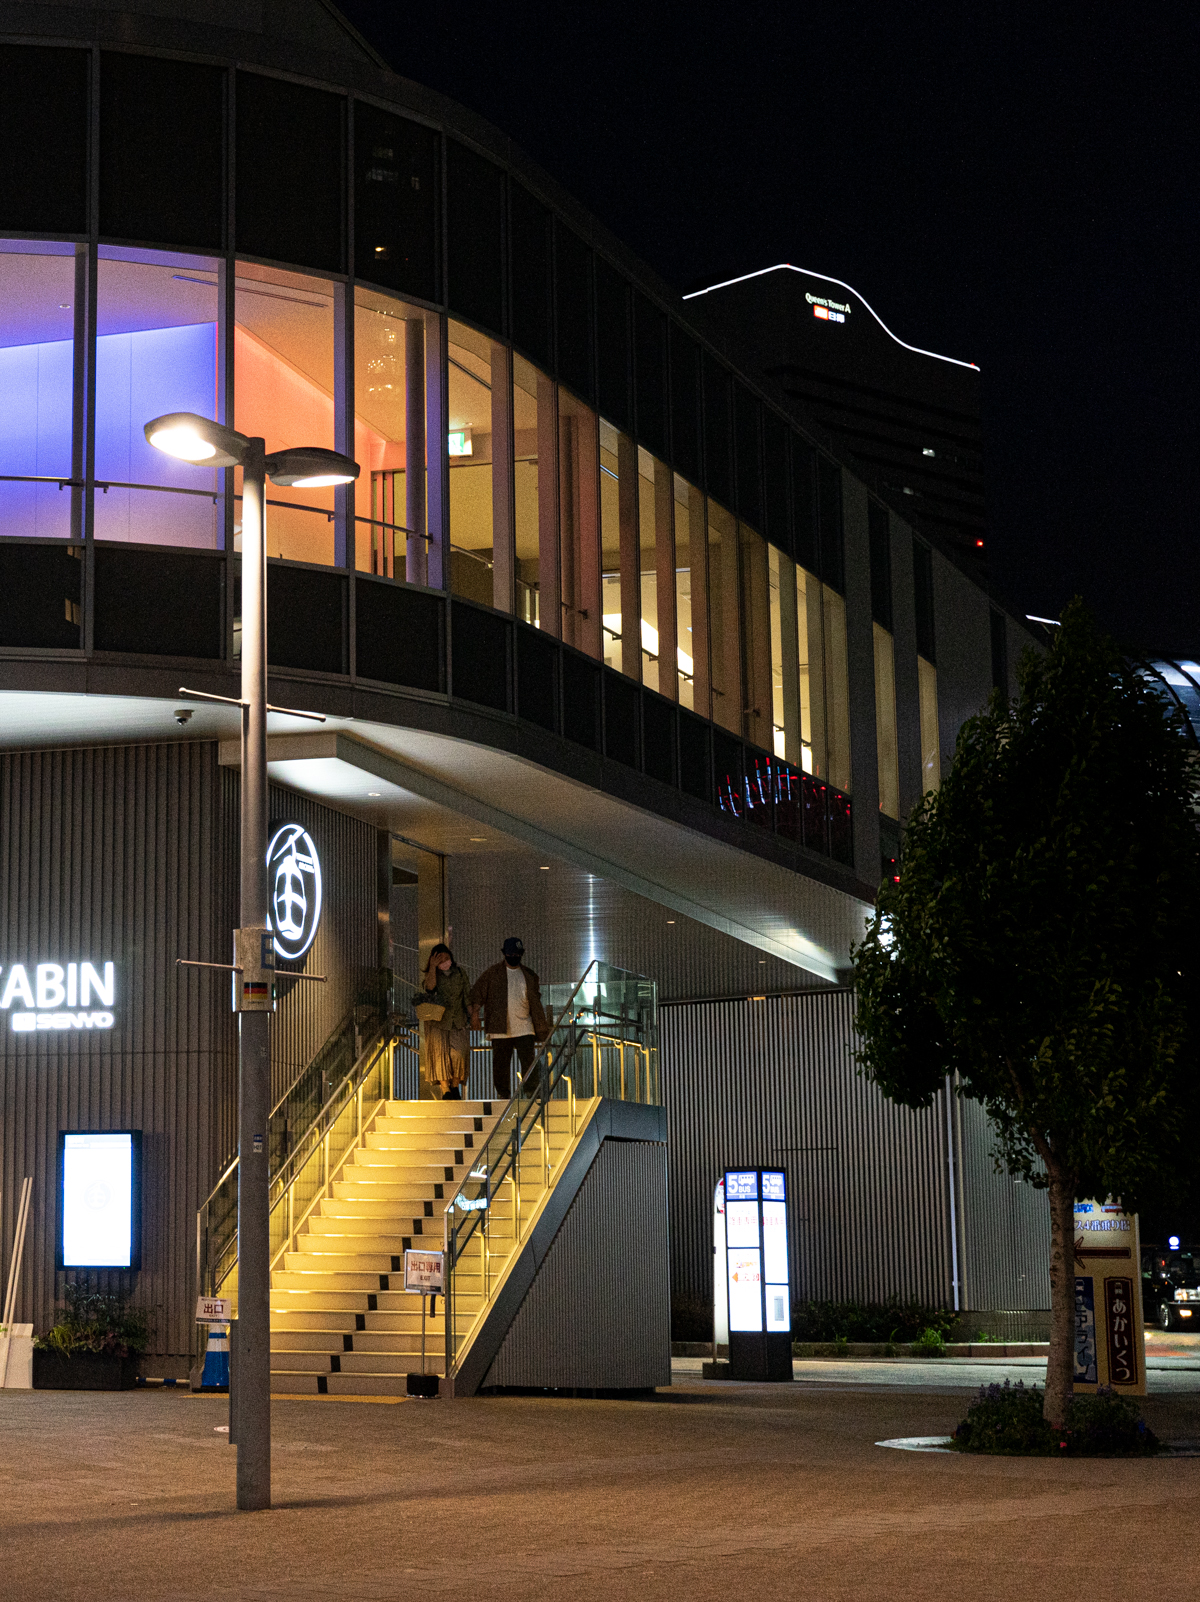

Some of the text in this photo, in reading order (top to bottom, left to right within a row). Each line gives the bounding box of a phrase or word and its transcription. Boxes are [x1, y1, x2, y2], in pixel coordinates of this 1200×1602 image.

[845, 303, 851, 314] A
[37, 1012, 114, 1030] SENYO
[90, 1059, 101, 1079] F
[728, 1175, 738, 1193] 5
[762, 1175, 770, 1193] 5
[1074, 1219, 1130, 1231] ス4番乗り場
[411, 1261, 440, 1273] 出口専用
[204, 1303, 223, 1314] 出口
[1113, 1298, 1130, 1380] あかいくつ
